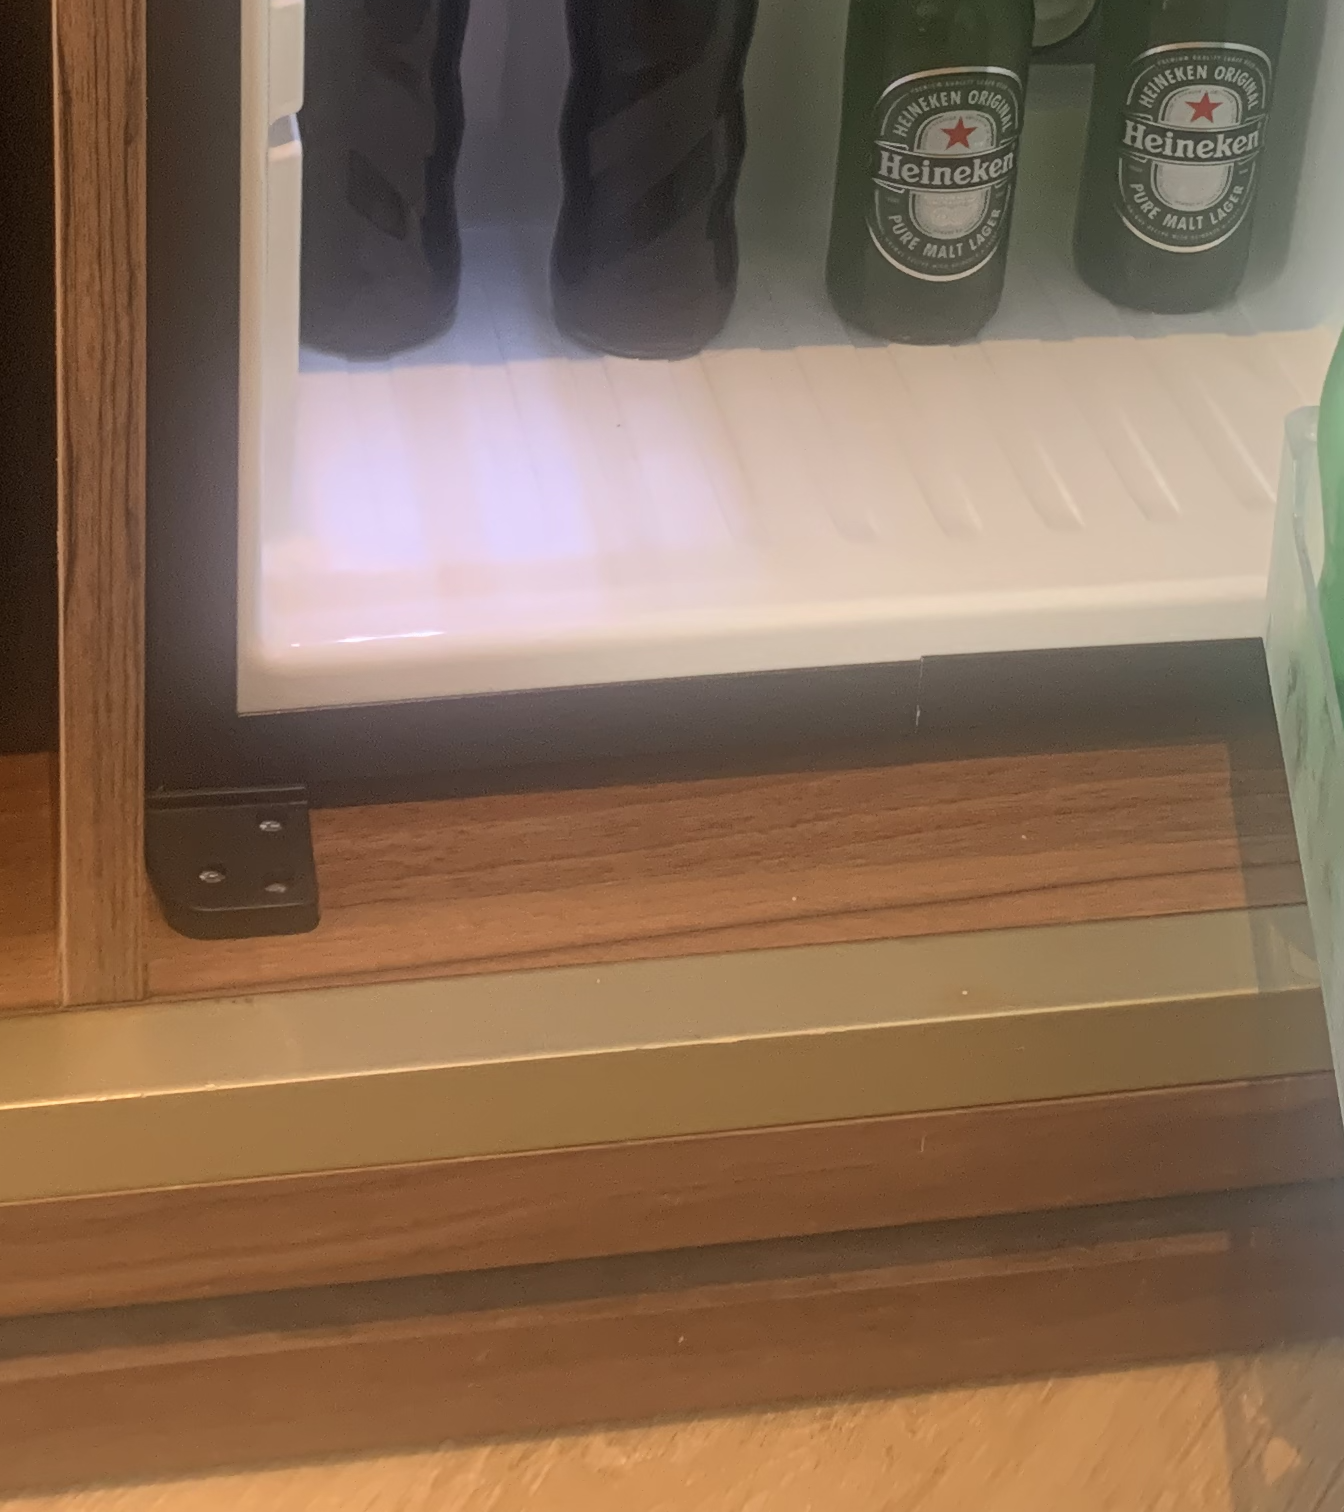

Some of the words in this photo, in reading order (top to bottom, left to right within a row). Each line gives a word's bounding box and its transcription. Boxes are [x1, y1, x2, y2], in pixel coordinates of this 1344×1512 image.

[1139, 65, 1208, 109] HEINEKEN
[1214, 65, 1260, 111] ORIGINAL
[892, 90, 961, 137] HEINEKEN
[968, 89, 1013, 133] ORIGINAL
[1122, 120, 1260, 159] Heineken
[878, 150, 1014, 186] Heineken
[1130, 183, 1162, 220] PURE
[1162, 212, 1204, 231] MALT
[1209, 185, 1244, 225] LAGER
[889, 214, 920, 250] PURE
[923, 242, 963, 259] MALT
[969, 209, 1001, 251] LAGER
